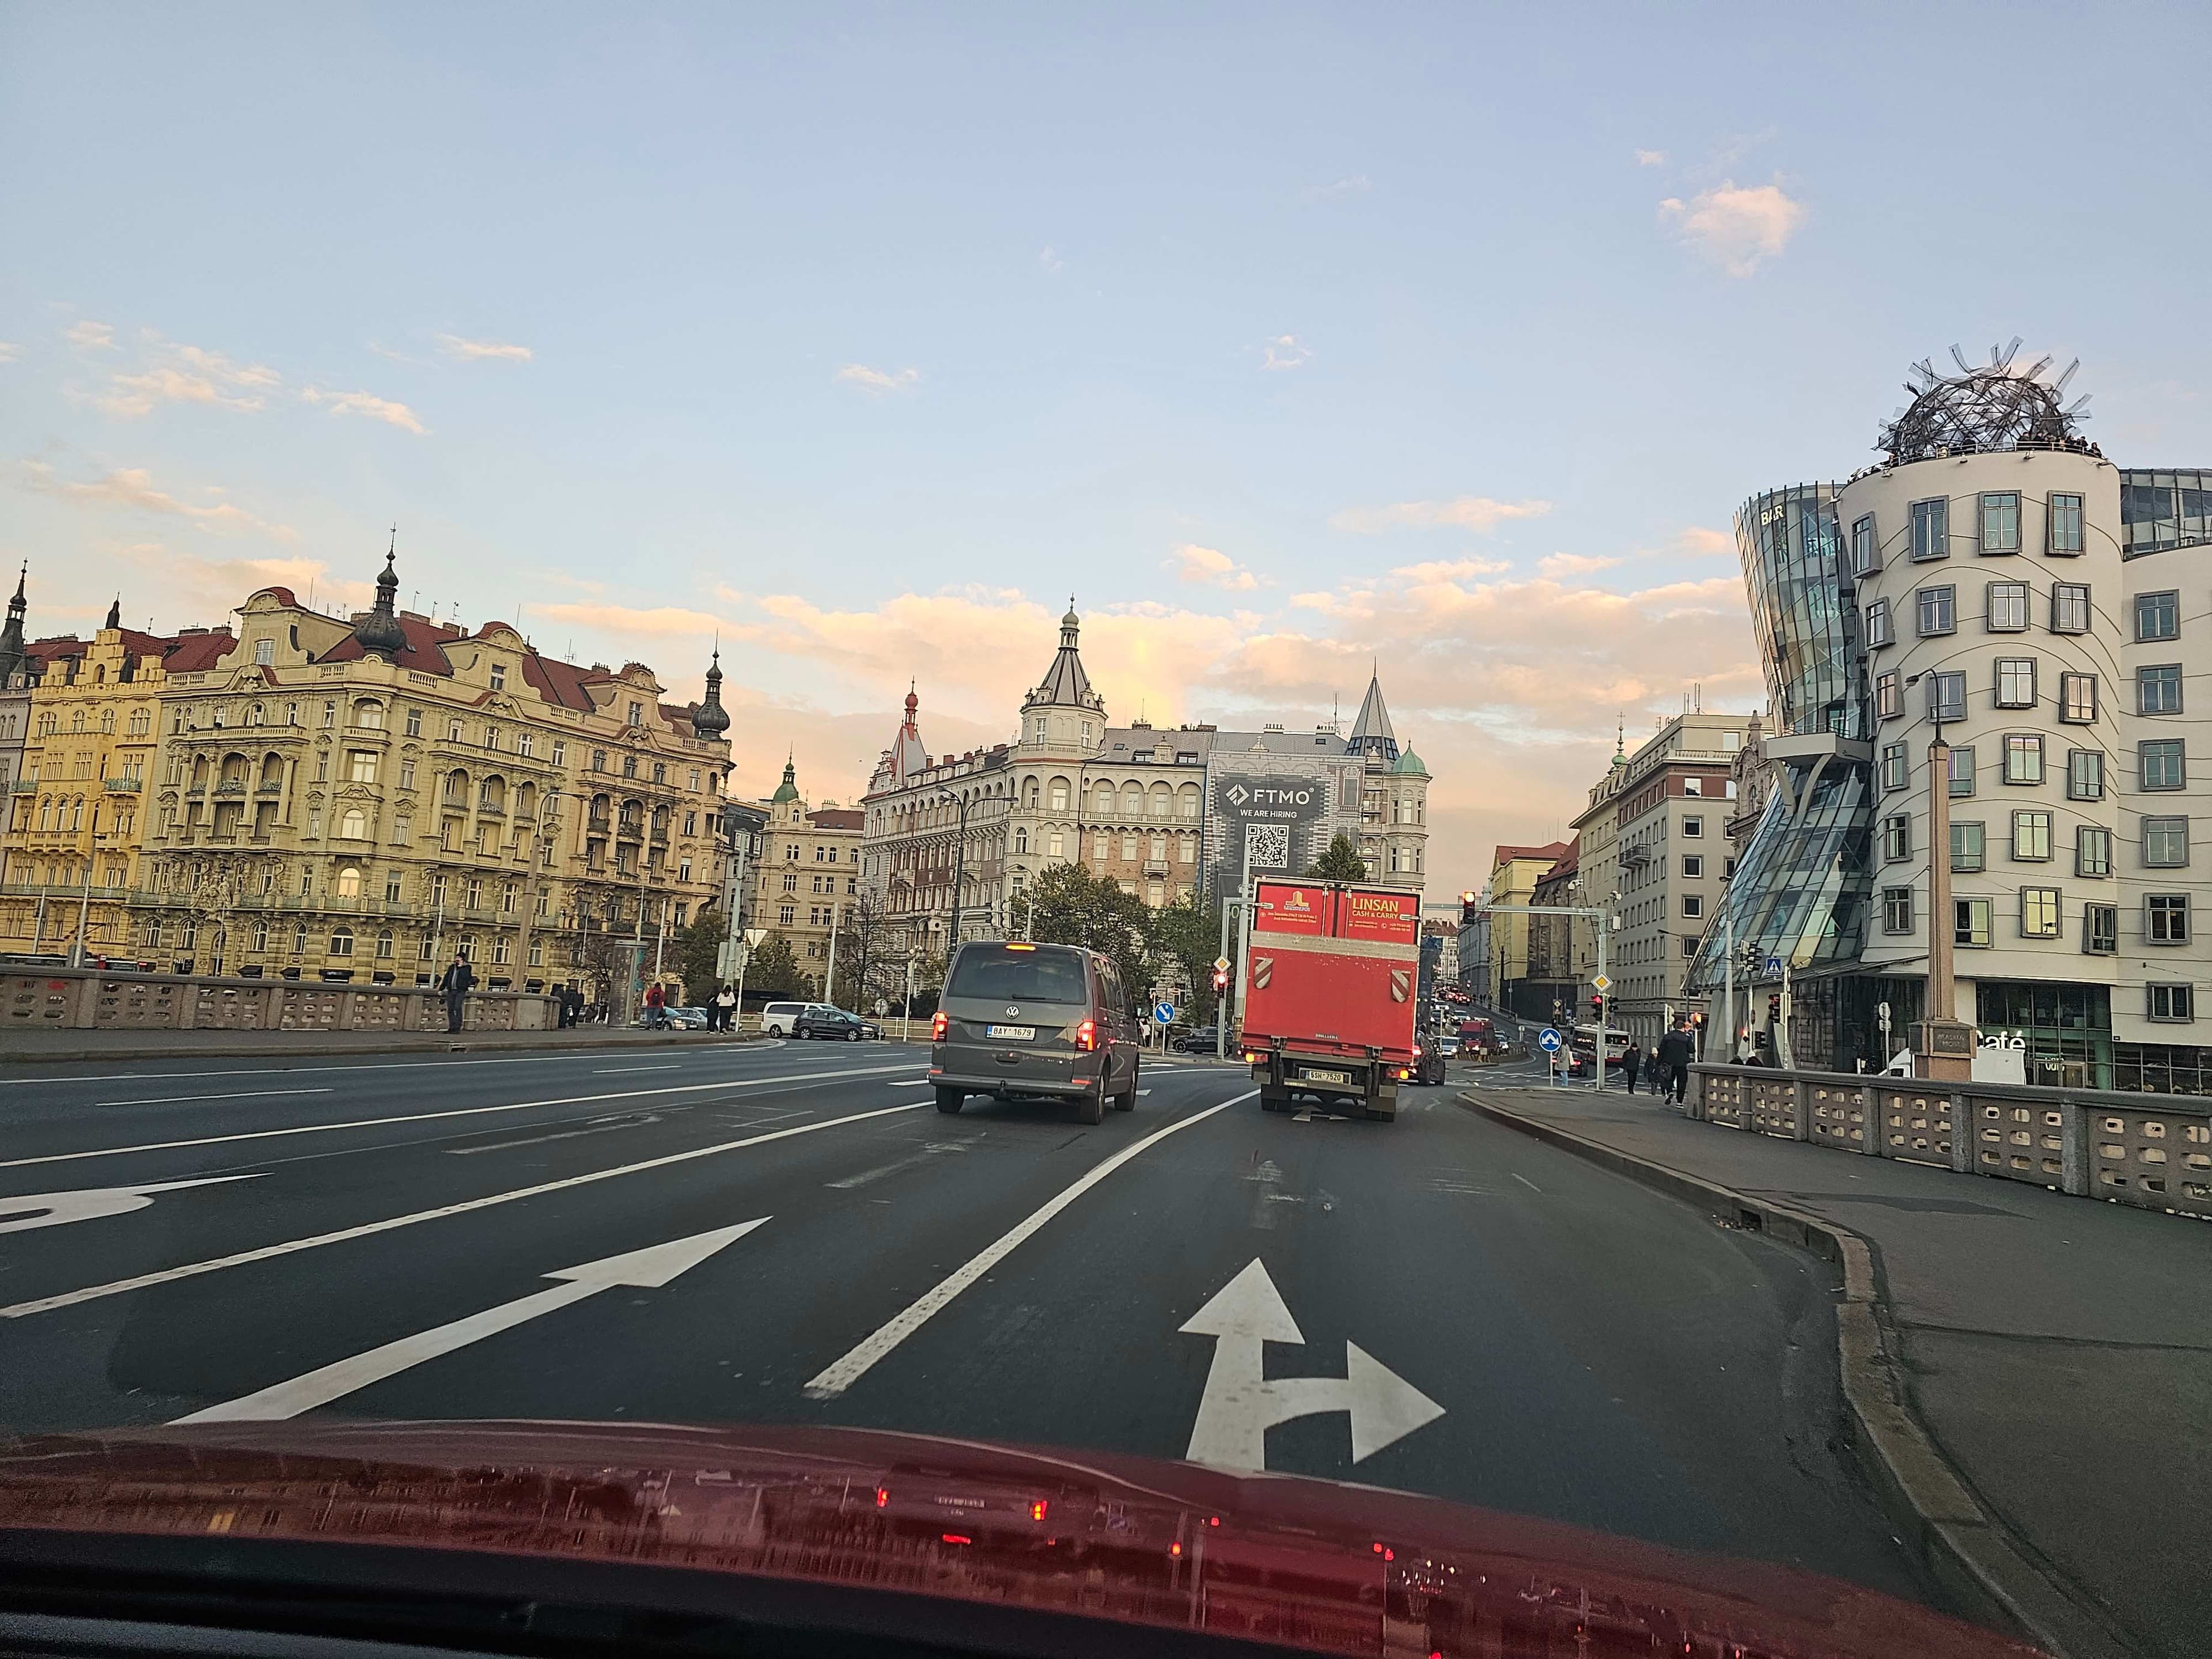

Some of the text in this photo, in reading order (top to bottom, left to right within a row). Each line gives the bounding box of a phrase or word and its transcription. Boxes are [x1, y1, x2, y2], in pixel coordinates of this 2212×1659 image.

[1761, 505, 1784, 525] BAR
[1253, 789, 1310, 805] FTMO
[1253, 809, 1269, 817] ARE
[1270, 810, 1297, 819] HIRING
[1353, 898, 1399, 912] LINSAN
[1014, 1028, 1031, 1036] 1679
